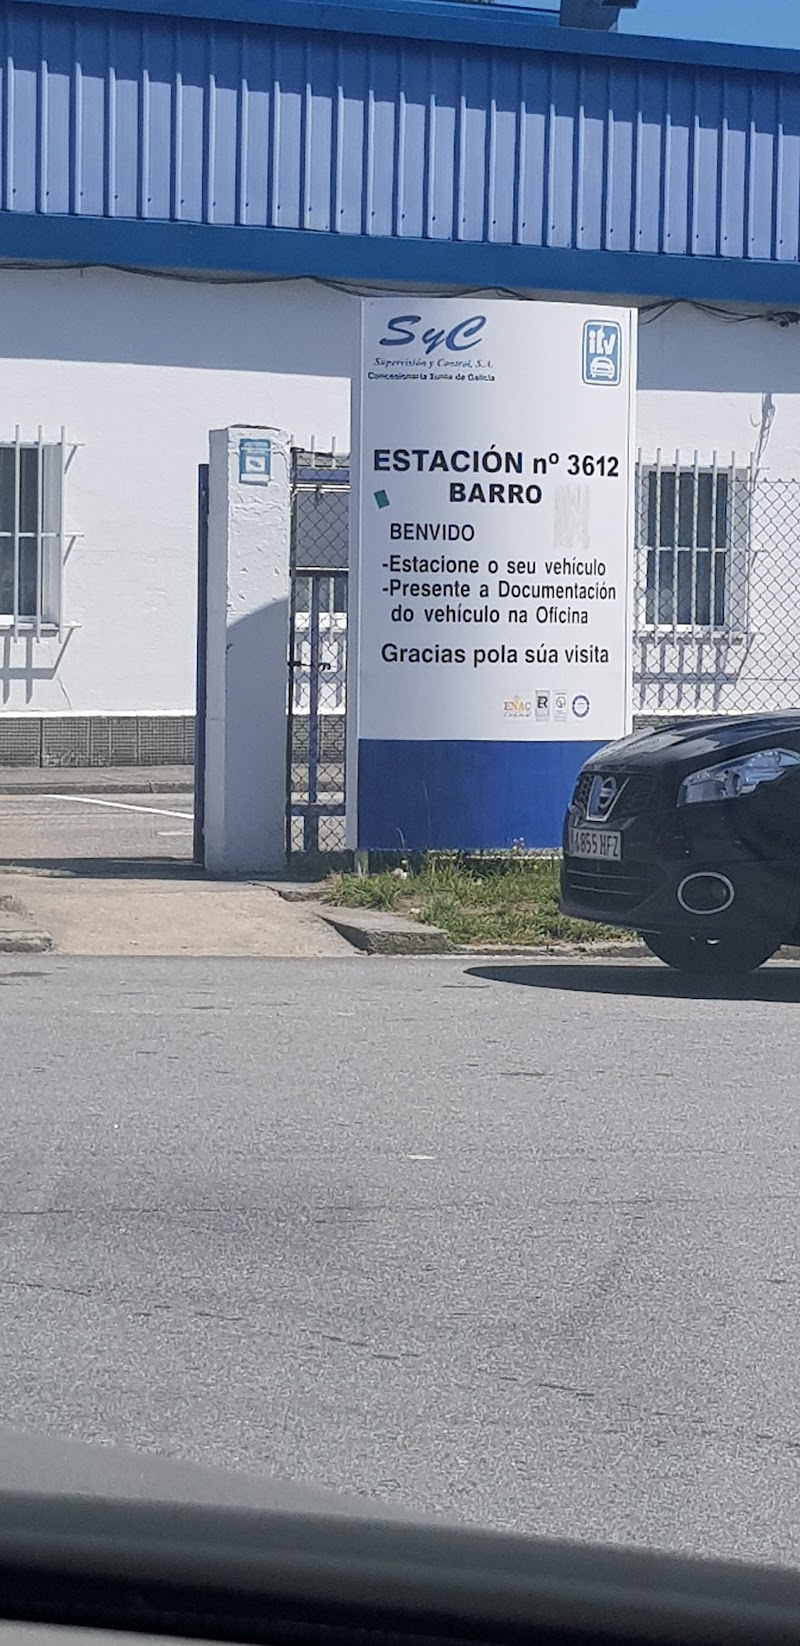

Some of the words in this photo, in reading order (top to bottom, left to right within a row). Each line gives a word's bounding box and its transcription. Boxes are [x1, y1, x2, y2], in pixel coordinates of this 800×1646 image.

[379, 315, 486, 355] SyC
[374, 357, 426, 368] Supervisión
[428, 360, 435, 369] y
[455, 373, 465, 381] de
[373, 444, 523, 474] ESTACIÓN
[567, 454, 619, 477] 3612
[450, 482, 542, 504] BARRO
[390, 523, 475, 541] BENVIDO
[382, 555, 480, 574] -Estacione
[488, 560, 499, 574] o
[507, 560, 536, 575] seu
[545, 556, 606, 576] vehículo
[382, 579, 470, 598] -Presente
[479, 584, 489, 598] a
[498, 580, 616, 600] Documentación
[391, 604, 414, 623] do
[424, 603, 500, 623] vehículo
[508, 609, 528, 623] na
[381, 643, 466, 664] Gracias
[474, 644, 518, 668] pola
[525, 643, 558, 664] súa
[564, 645, 609, 664] visita
